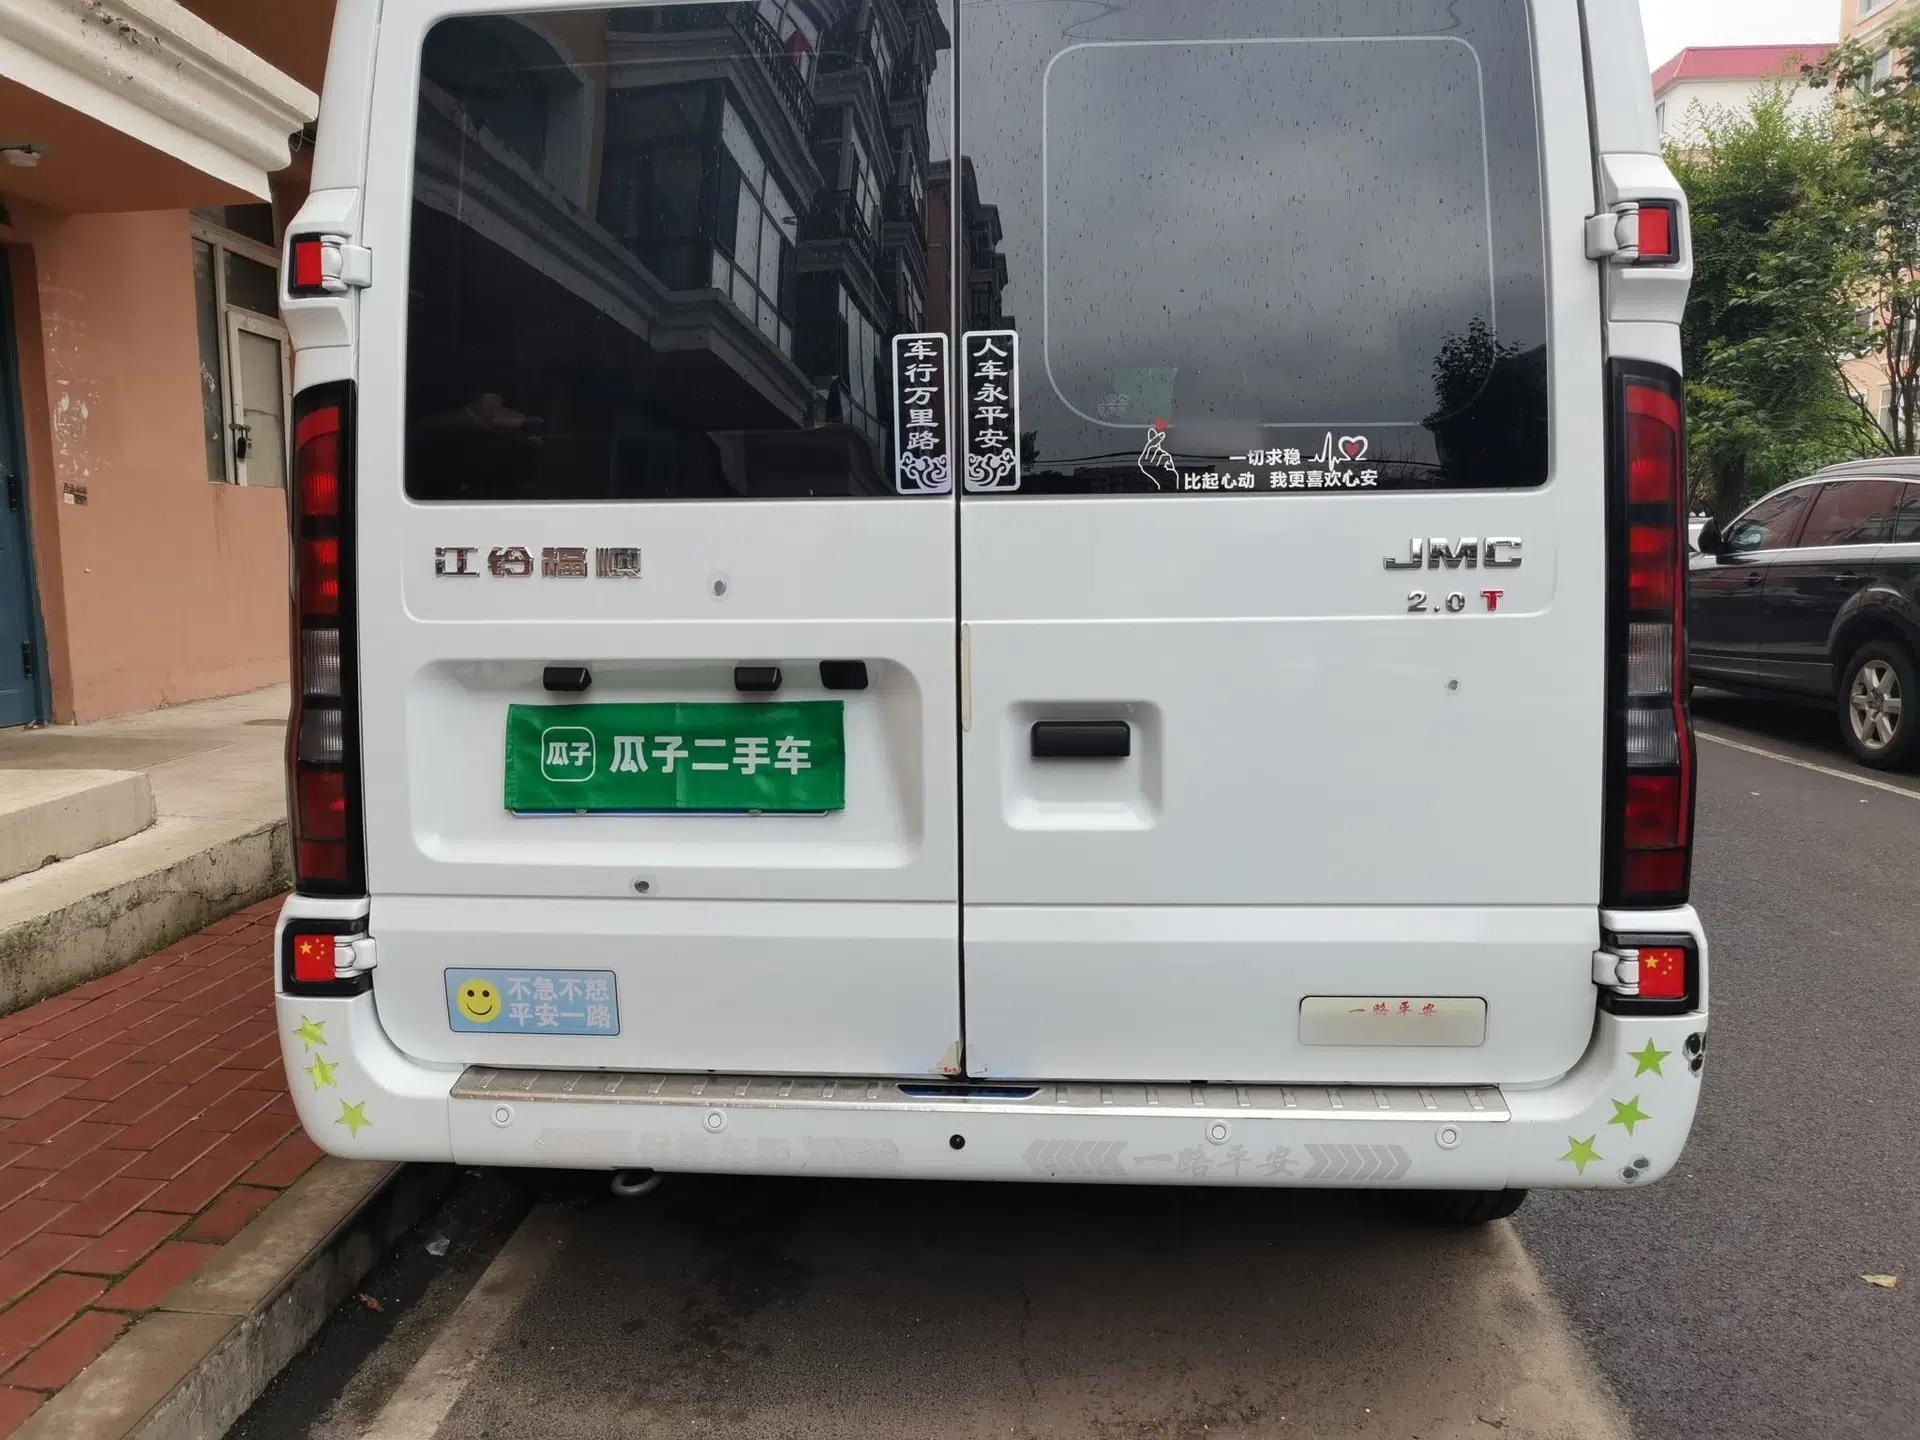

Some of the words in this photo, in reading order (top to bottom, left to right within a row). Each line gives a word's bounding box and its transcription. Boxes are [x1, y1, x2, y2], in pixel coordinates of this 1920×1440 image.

[904, 340, 939, 450] 车行万里路
[973, 338, 1009, 449] 人车永平安
[1229, 449, 1301, 466] 一切求稳
[1184, 472, 1255, 490] 比起心动
[1270, 469, 1378, 488] 我更喜欢心安
[1383, 537, 1522, 570] JMC
[546, 742, 592, 766] 瓜子
[610, 736, 812, 775] 瓜子二手车
[509, 1003, 612, 1029] 平安一路
[1348, 1000, 1437, 1016] 一路平安
[1133, 1143, 1300, 1178] 一路平安
